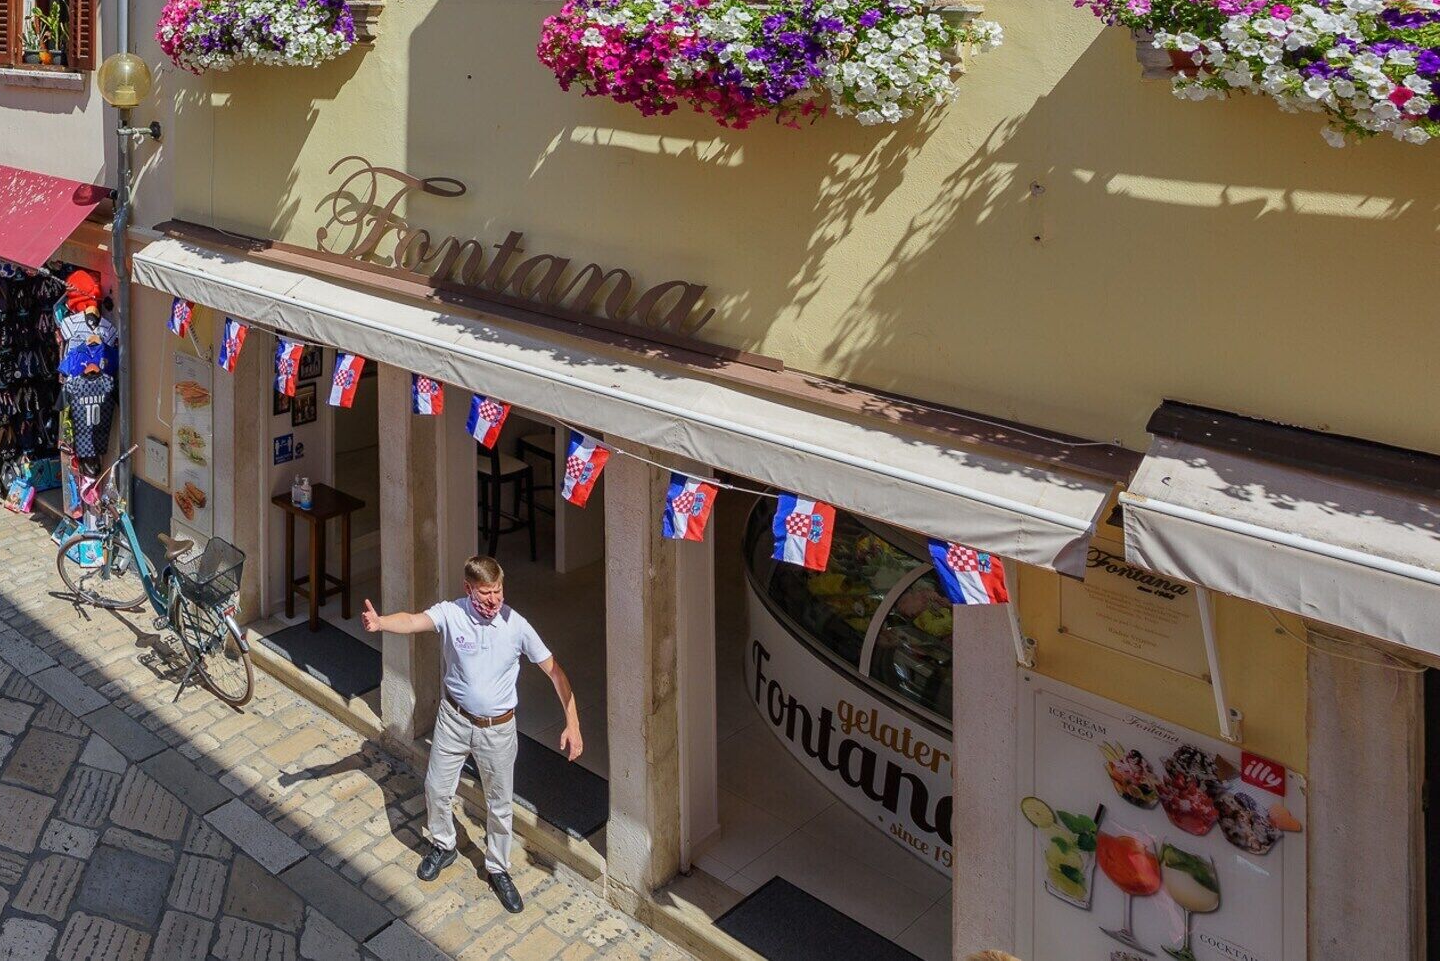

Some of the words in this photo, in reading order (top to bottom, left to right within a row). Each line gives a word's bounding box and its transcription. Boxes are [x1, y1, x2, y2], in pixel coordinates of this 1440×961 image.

[316, 156, 716, 336] Fontana
[85, 404, 101, 426] 10
[1086, 546, 1189, 596] Fontana
[837, 699, 953, 775] gelater
[1061, 721, 1076, 732] TO
[1077, 728, 1094, 740] GO
[1068, 714, 1107, 735] CREAM
[1243, 759, 1282, 787] illy
[889, 822, 929, 856] since
